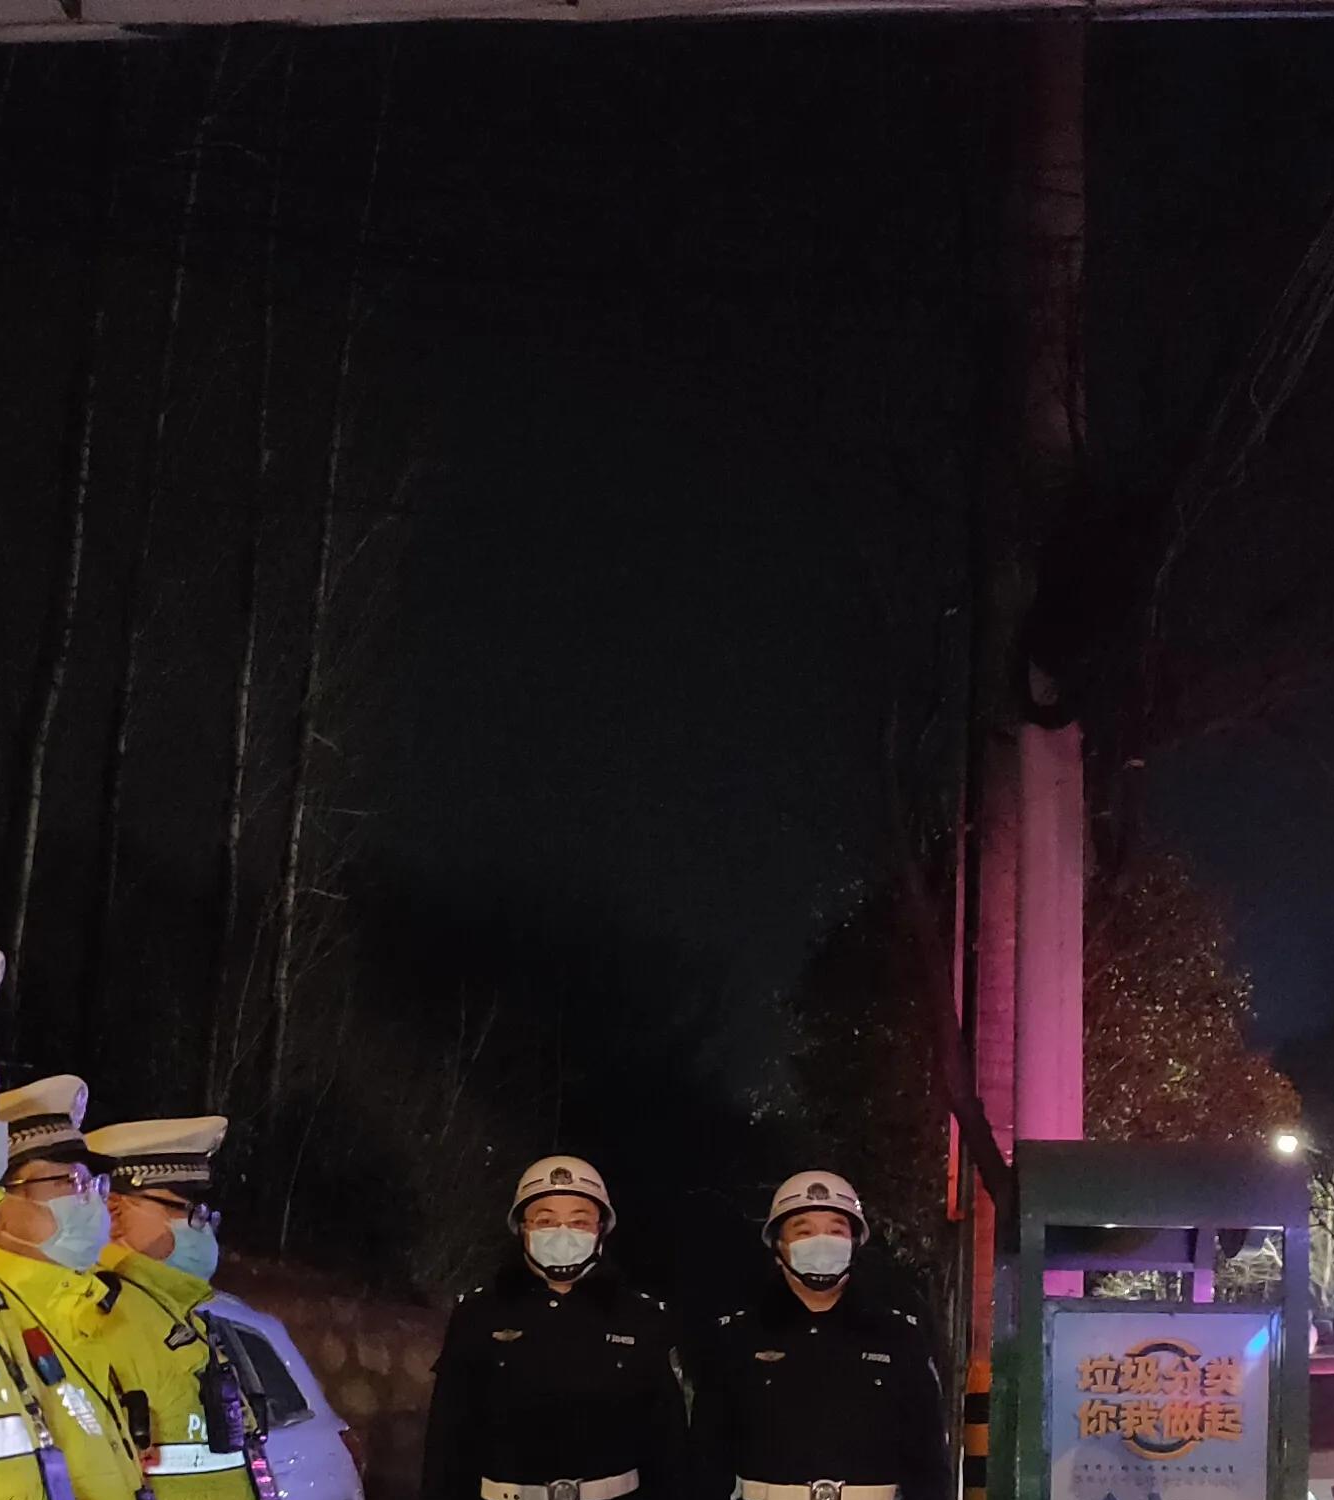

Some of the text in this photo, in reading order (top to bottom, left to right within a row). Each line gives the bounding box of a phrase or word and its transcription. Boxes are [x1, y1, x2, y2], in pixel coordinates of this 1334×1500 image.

[1077, 1354, 1245, 1396] 垃圾分类
[1074, 1399, 1243, 1441] 你我做起
